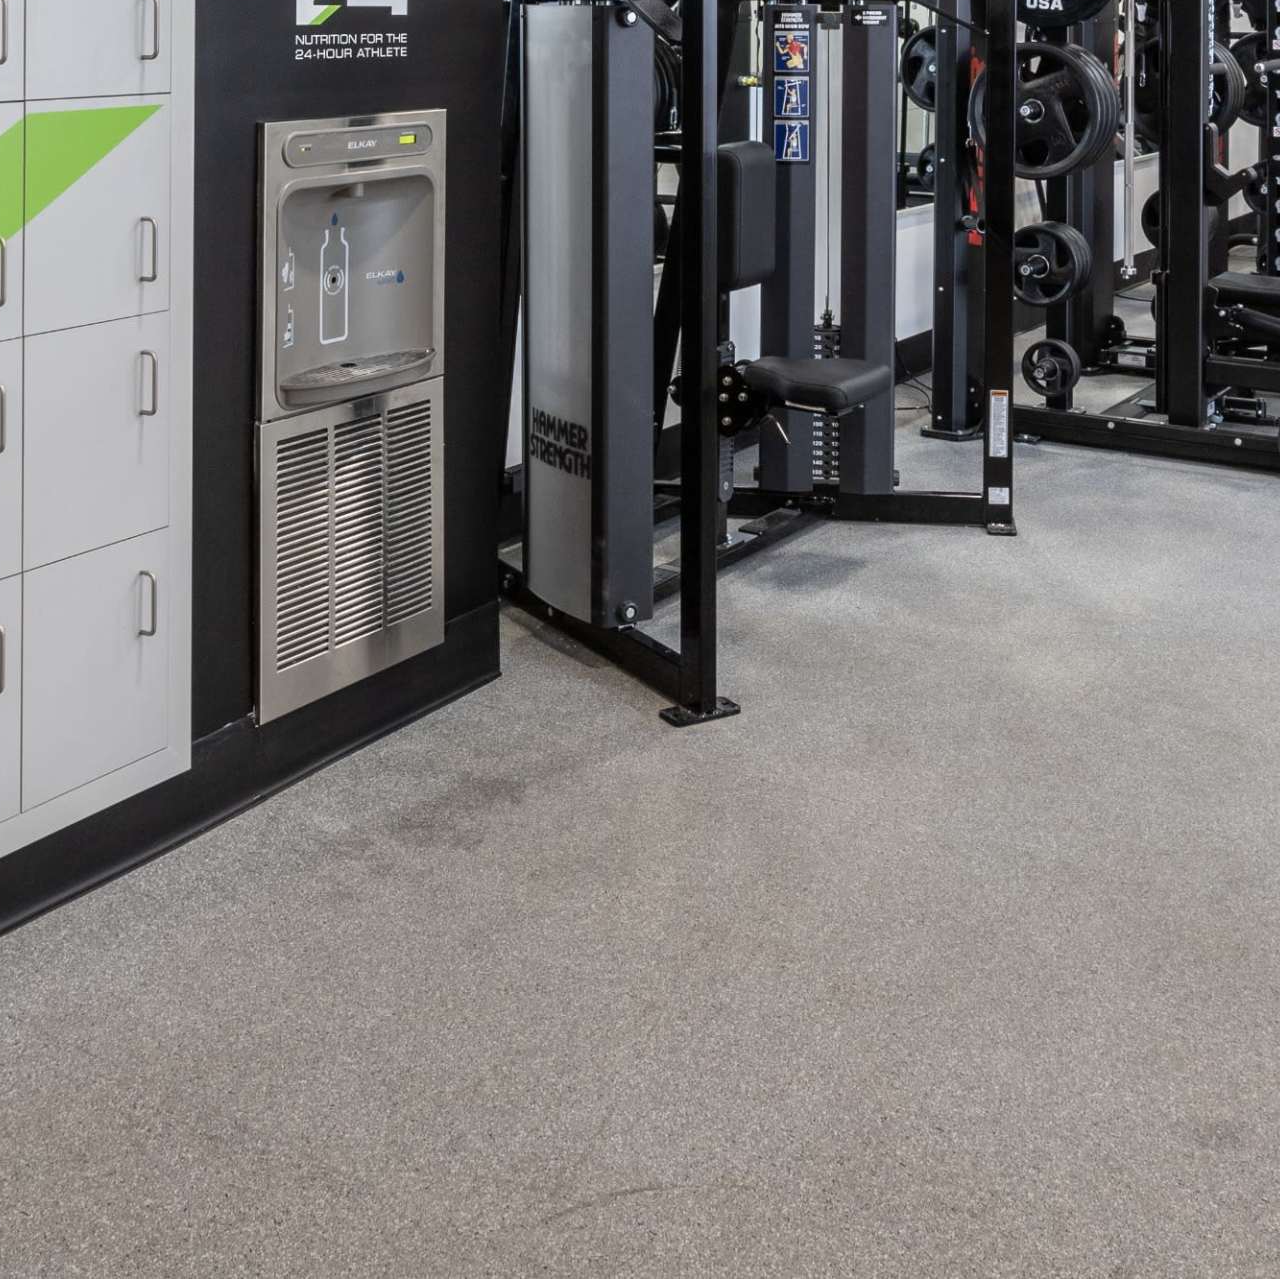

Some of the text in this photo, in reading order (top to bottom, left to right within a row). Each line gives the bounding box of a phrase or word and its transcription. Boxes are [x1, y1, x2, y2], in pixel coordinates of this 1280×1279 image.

[295, 33, 408, 46] NUTRITION FOR THE
[295, 46, 408, 60] 24-HOUR ATHLETE
[347, 140, 377, 150] ELKAY
[365, 271, 395, 280] ELKAY
[532, 406, 588, 452] HAMMER
[530, 432, 592, 480] STRENGTH
